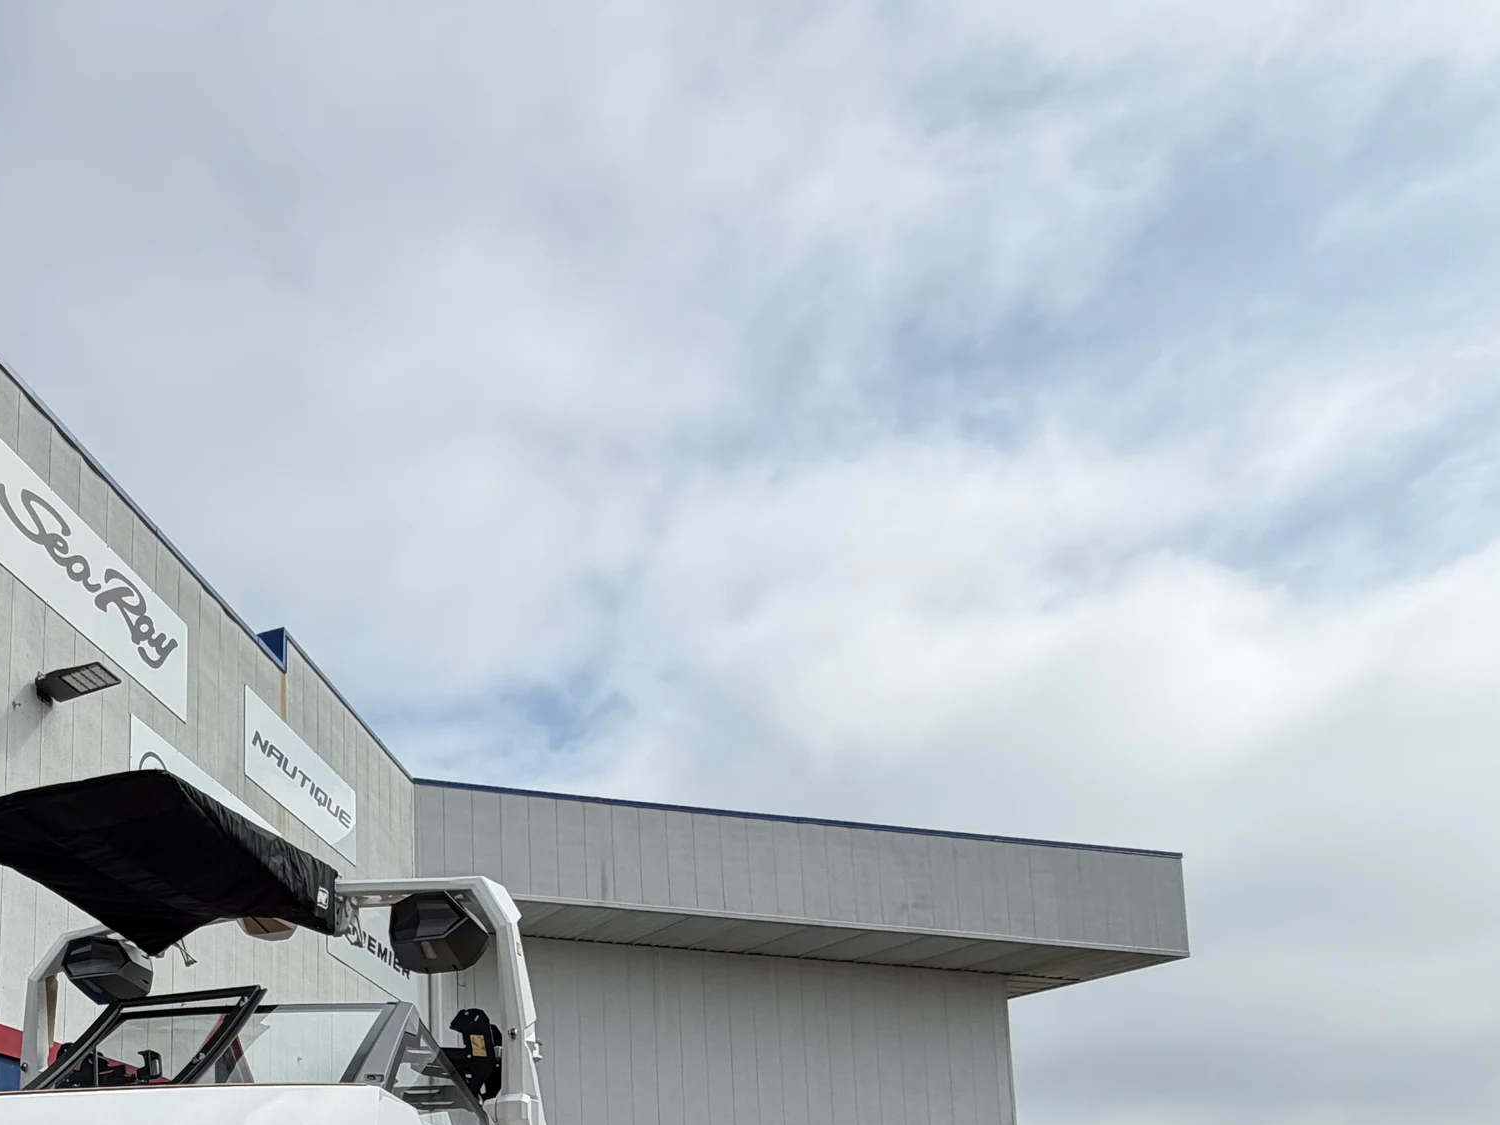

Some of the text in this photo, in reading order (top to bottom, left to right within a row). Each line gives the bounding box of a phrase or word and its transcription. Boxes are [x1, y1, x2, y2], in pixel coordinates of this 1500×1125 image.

[94, 568, 179, 670] Ray
[252, 730, 352, 829] NAUTIQUE
[361, 930, 411, 980] EMIER
